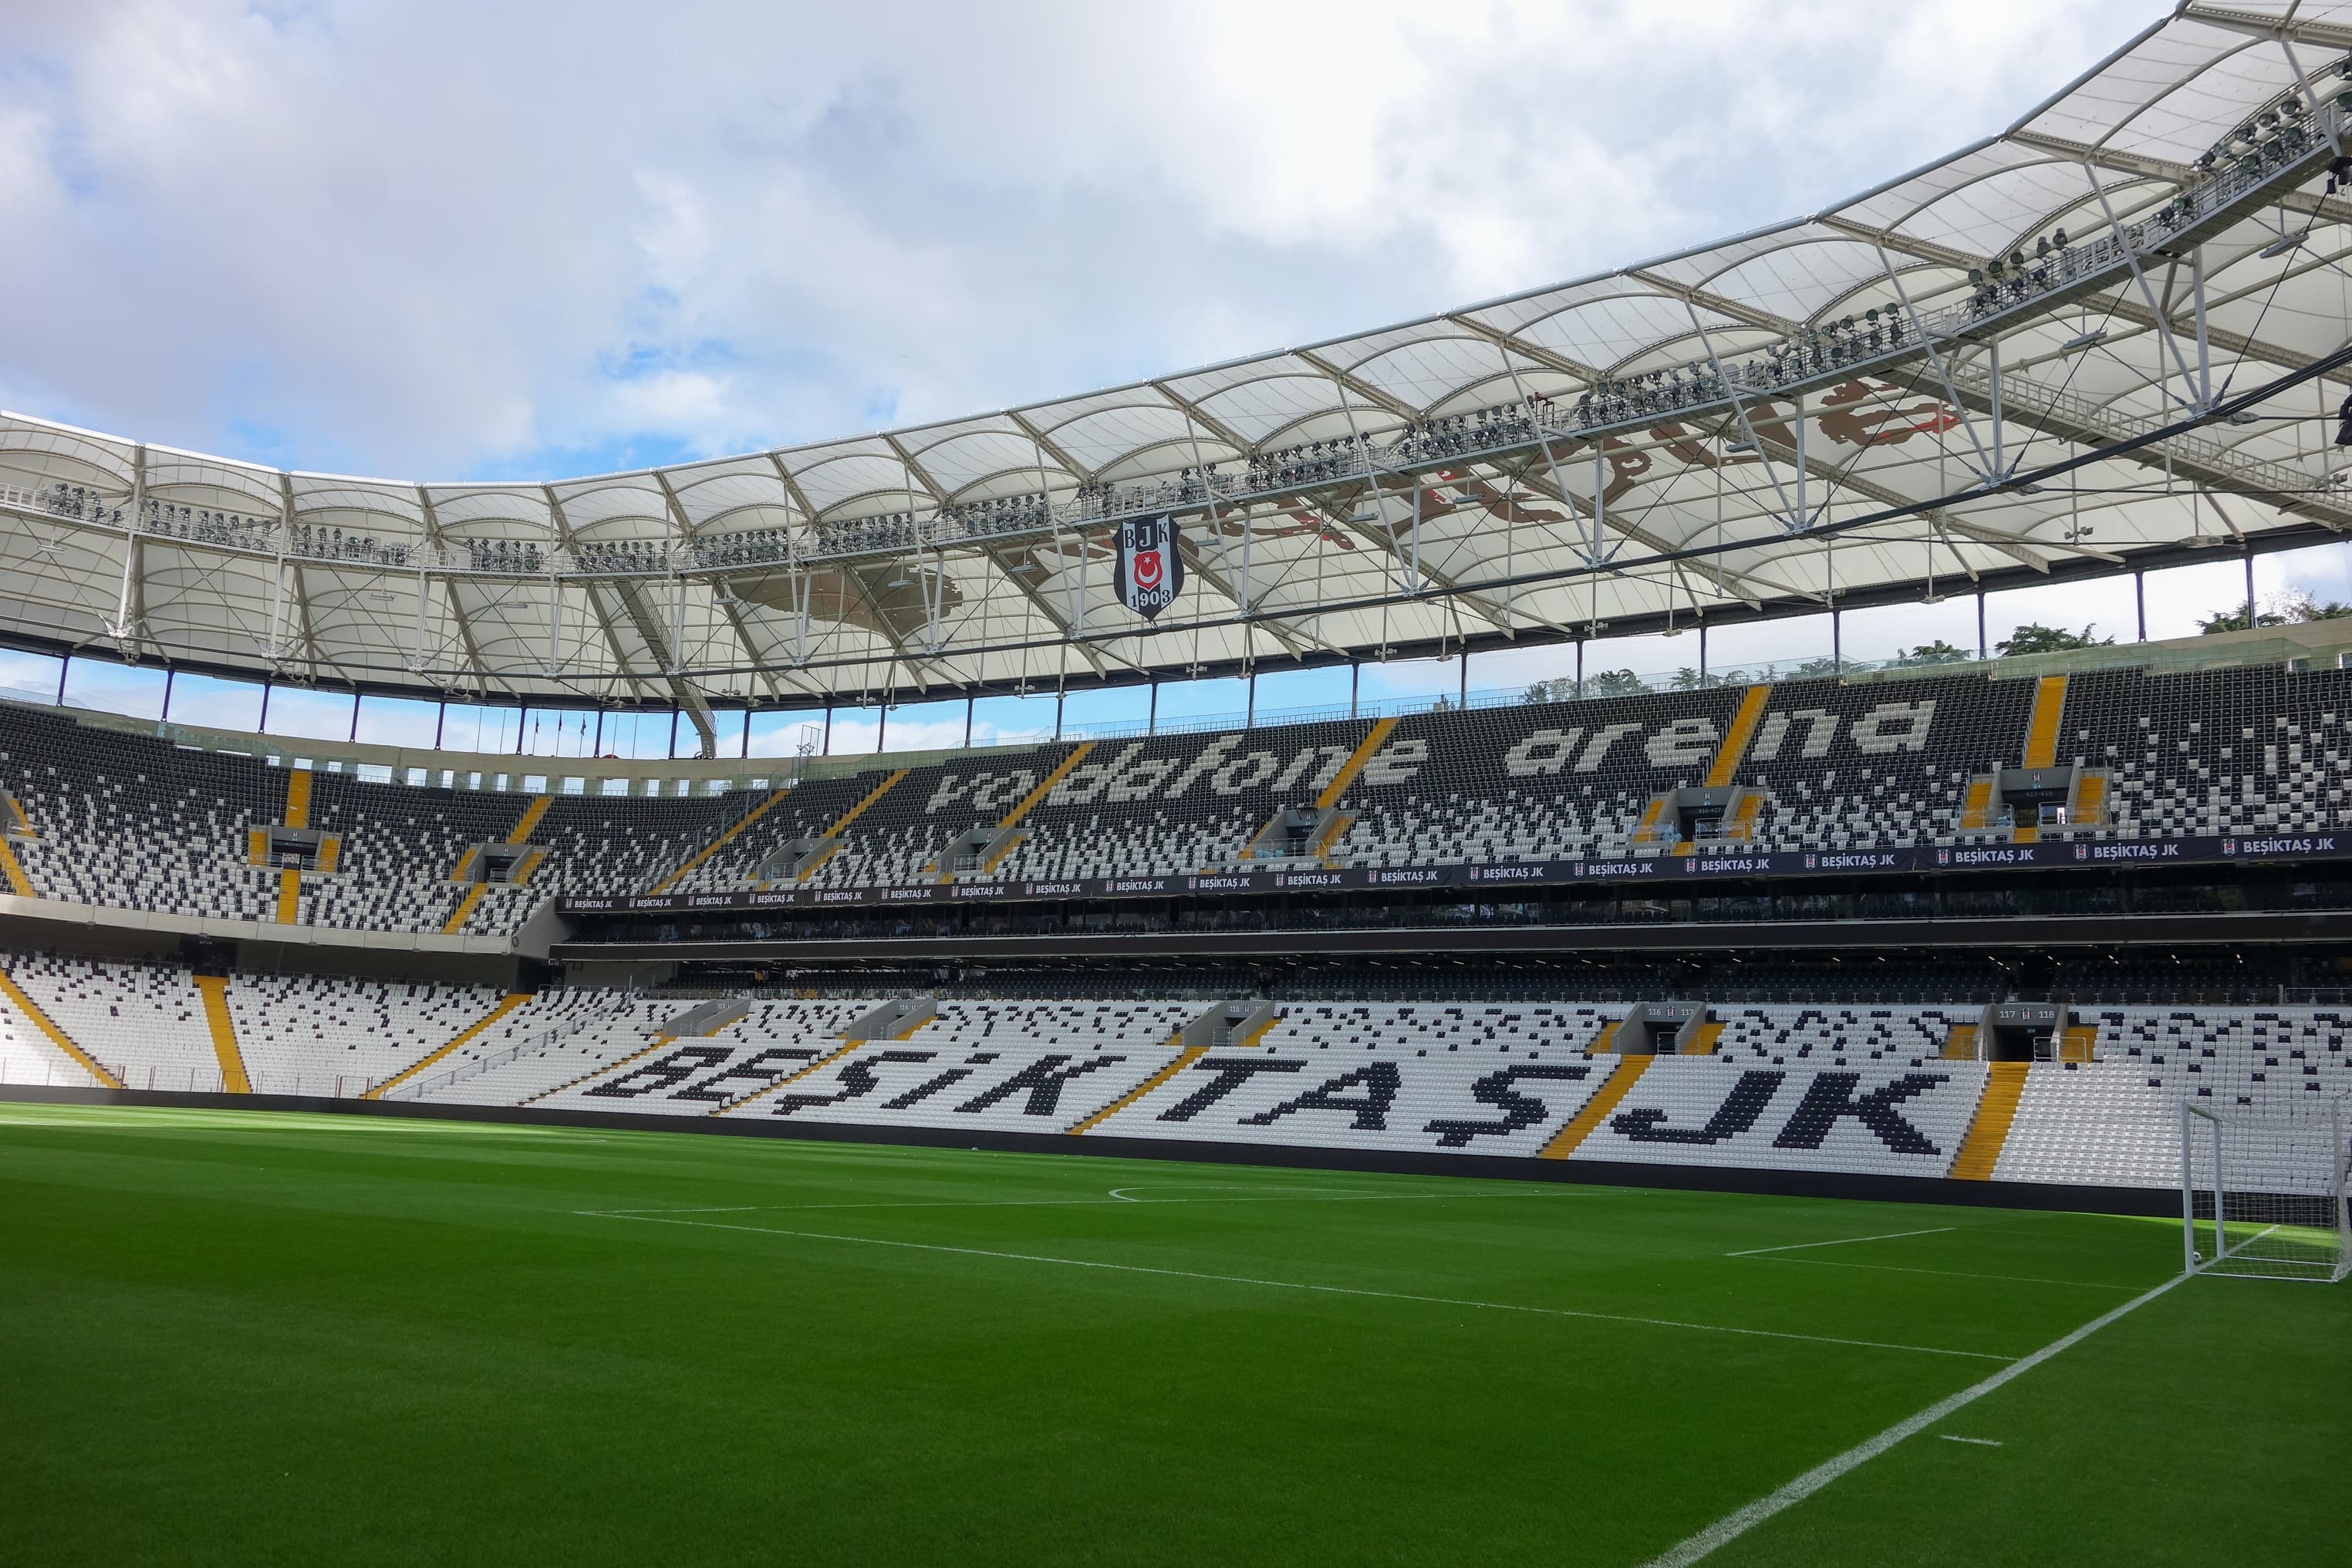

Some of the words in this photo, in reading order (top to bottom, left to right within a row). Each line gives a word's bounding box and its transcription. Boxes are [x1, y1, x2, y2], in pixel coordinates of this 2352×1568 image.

[1125, 523, 1169, 548] BJK
[1131, 590, 1171, 607] 1903
[1505, 700, 1937, 776] arena
[2094, 842, 2158, 861] BEŞİKTAŞ
[2161, 844, 2178, 856] JK
[2243, 837, 2312, 855] BEŞİKTAŞ
[2315, 838, 2334, 850] JK
[1821, 852, 1876, 870] BEŞİKTAŞ
[1879, 855, 1895, 866] JK
[1956, 848, 2015, 865] BEŞİKTAŞ
[2017, 849, 2034, 861] JK
[1588, 861, 1636, 876] BEŞİKTAŞ
[1639, 863, 1653, 873] JK
[1701, 857, 1753, 873] BEŞİKTAŞ
[1755, 858, 1770, 870] JK
[1287, 873, 1328, 887] BEŞİKTAŞ
[1330, 875, 1341, 884] JK
[1381, 869, 1425, 884] BEŞİKTAŞ
[1426, 871, 1438, 881] JK
[1483, 865, 1529, 881] BEŞİKTAŞ
[1530, 866, 1544, 877] JK
[1035, 882, 1070, 896] BEŞİKTAŞ
[1071, 884, 1081, 892] JK
[1116, 879, 1152, 893] BEŞİKTAŞ
[1154, 881, 1164, 890] JK
[1200, 876, 1238, 890] BEŞİKTAŞ
[1239, 878, 1250, 887] JK
[786, 894, 795, 902] JK
[853, 892, 862, 900] JK
[922, 889, 932, 898] JK
[961, 885, 993, 898] BEŞİKTAŞ
[994, 886, 1004, 895] JK
[724, 896, 732, 905] JK
[1999, 1010, 2016, 1019] 117
[2039, 1010, 2055, 1019] 118
[1609, 1071, 1950, 1157] JK
